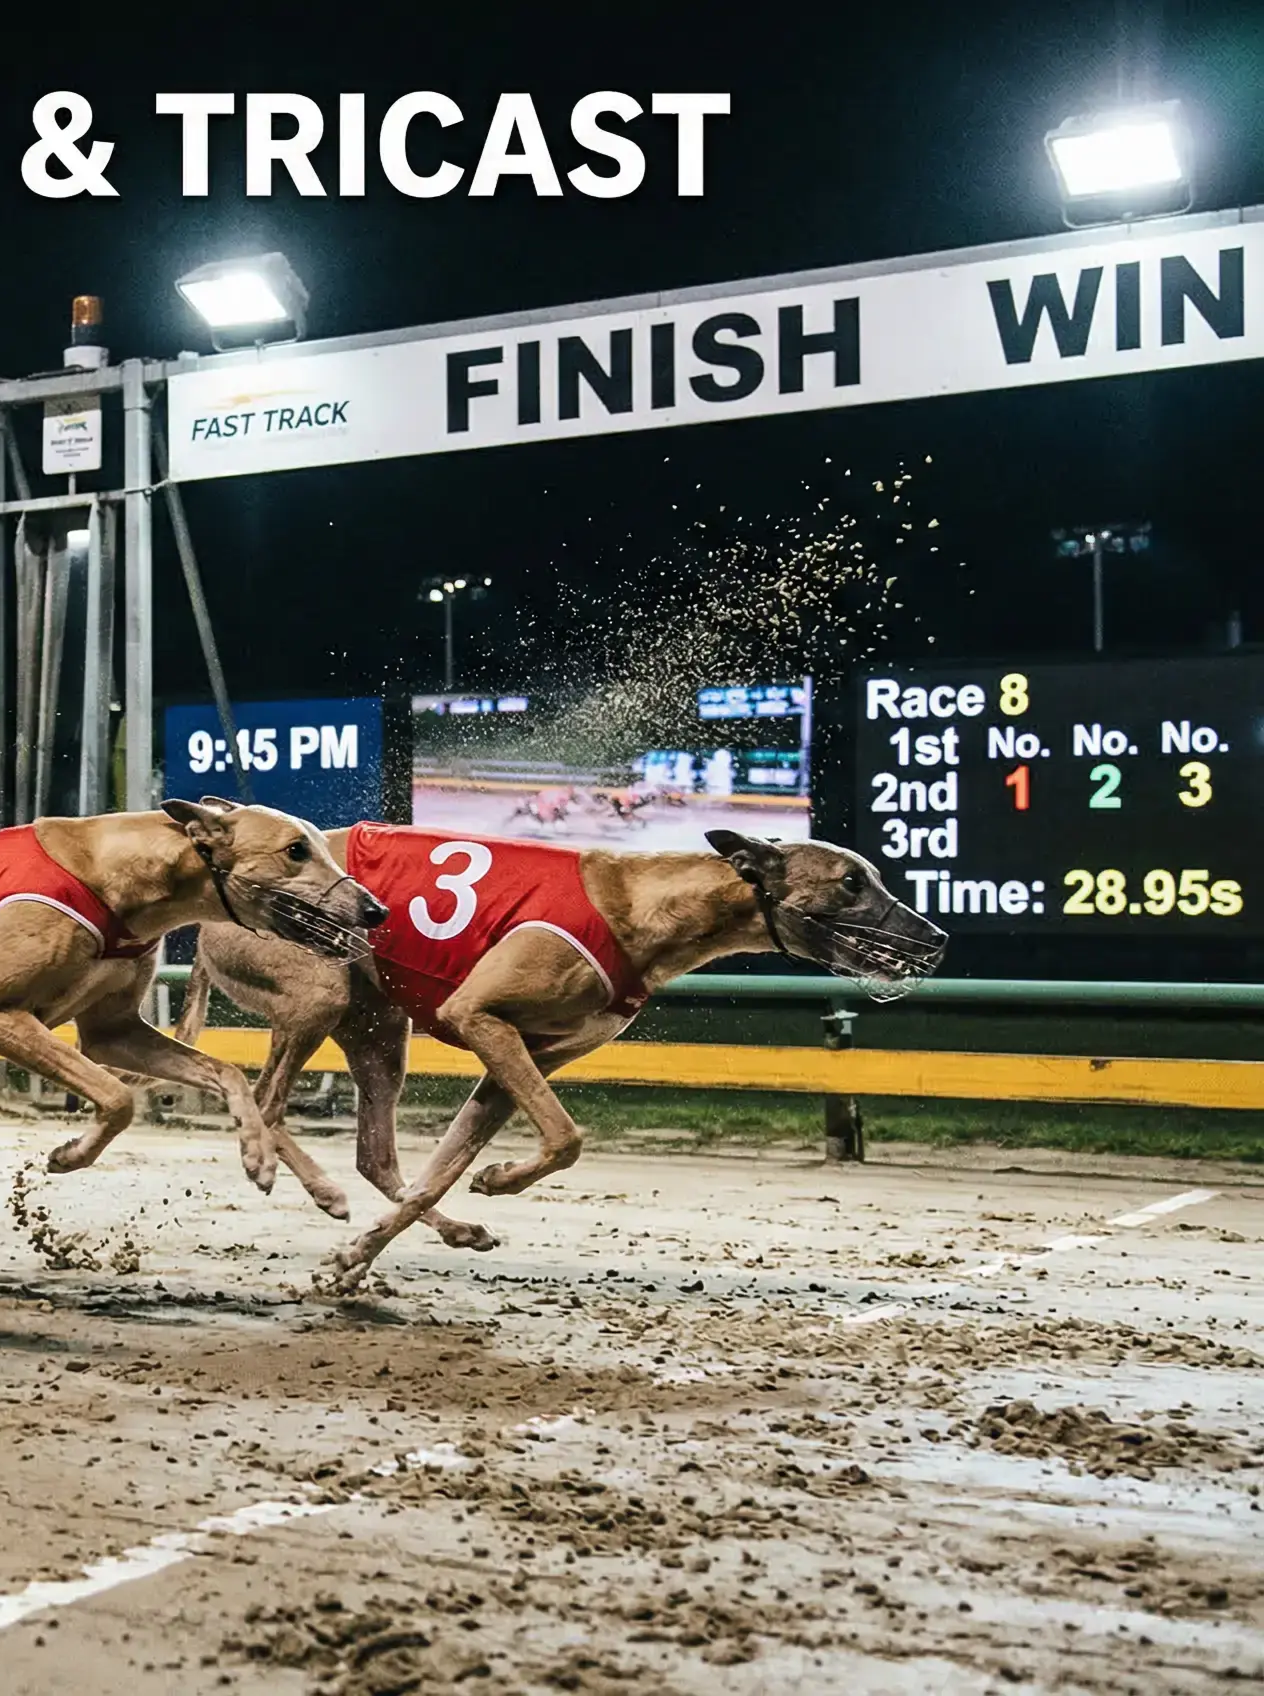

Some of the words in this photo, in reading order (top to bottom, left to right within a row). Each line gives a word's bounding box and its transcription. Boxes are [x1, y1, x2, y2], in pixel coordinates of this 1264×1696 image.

[446, 296, 862, 434] FINISH
[986, 246, 1246, 366] WIN
[191, 412, 255, 441] FAST
[263, 400, 350, 432] TRACK
[866, 678, 985, 720] Race
[999, 673, 1029, 716] 8
[188, 730, 278, 773] 9:45
[290, 724, 359, 770] PM
[889, 726, 960, 766] 1st
[988, 726, 1051, 759] No.
[1073, 723, 1138, 756] No.
[1161, 720, 1229, 753] No.
[871, 771, 958, 812] 2nd
[1005, 764, 1030, 811] 1
[1089, 763, 1122, 809] 2
[1178, 761, 1213, 808] 3
[881, 818, 958, 858] 3rd
[408, 840, 493, 940] 3
[905, 870, 1045, 914] Time:
[1063, 868, 1244, 916] 28.95s
